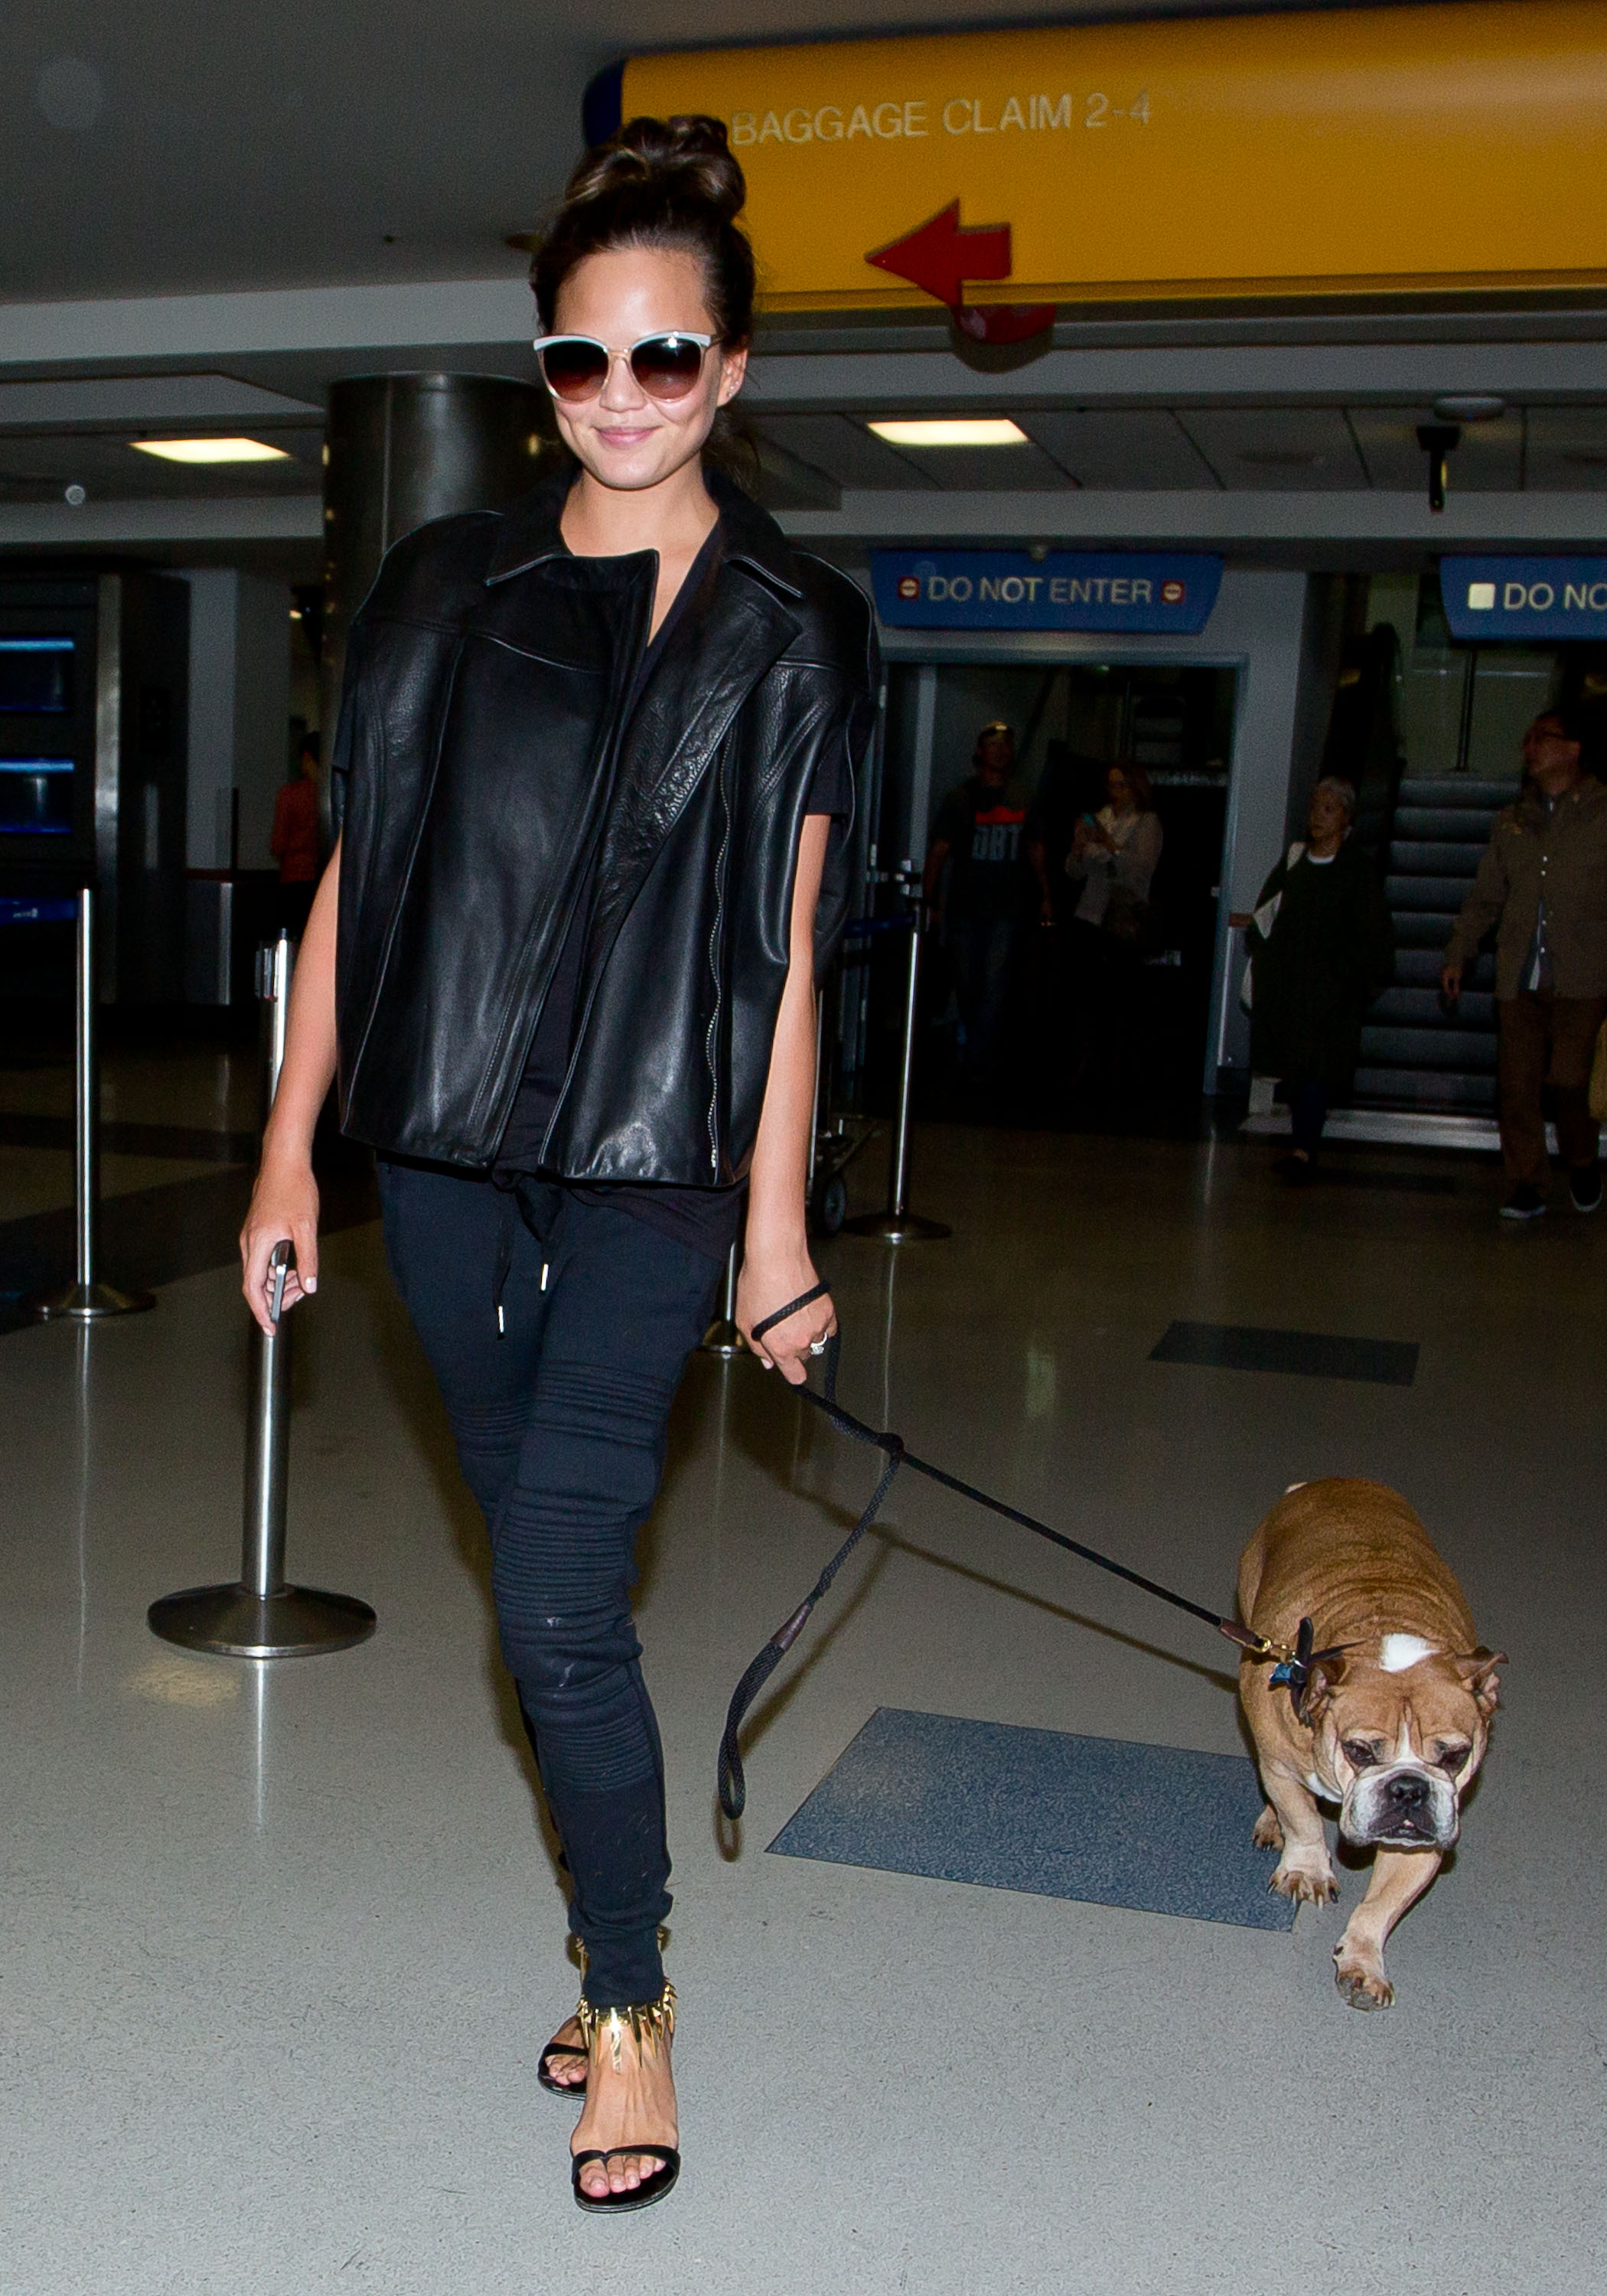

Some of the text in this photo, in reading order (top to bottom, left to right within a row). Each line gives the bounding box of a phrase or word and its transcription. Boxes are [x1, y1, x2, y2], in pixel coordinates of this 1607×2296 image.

[731, 91, 1152, 146] BAGGAGE CLAIM 2-4
[927, 576, 1152, 605] DO NOT ENTER
[1504, 582, 1555, 612] DO
